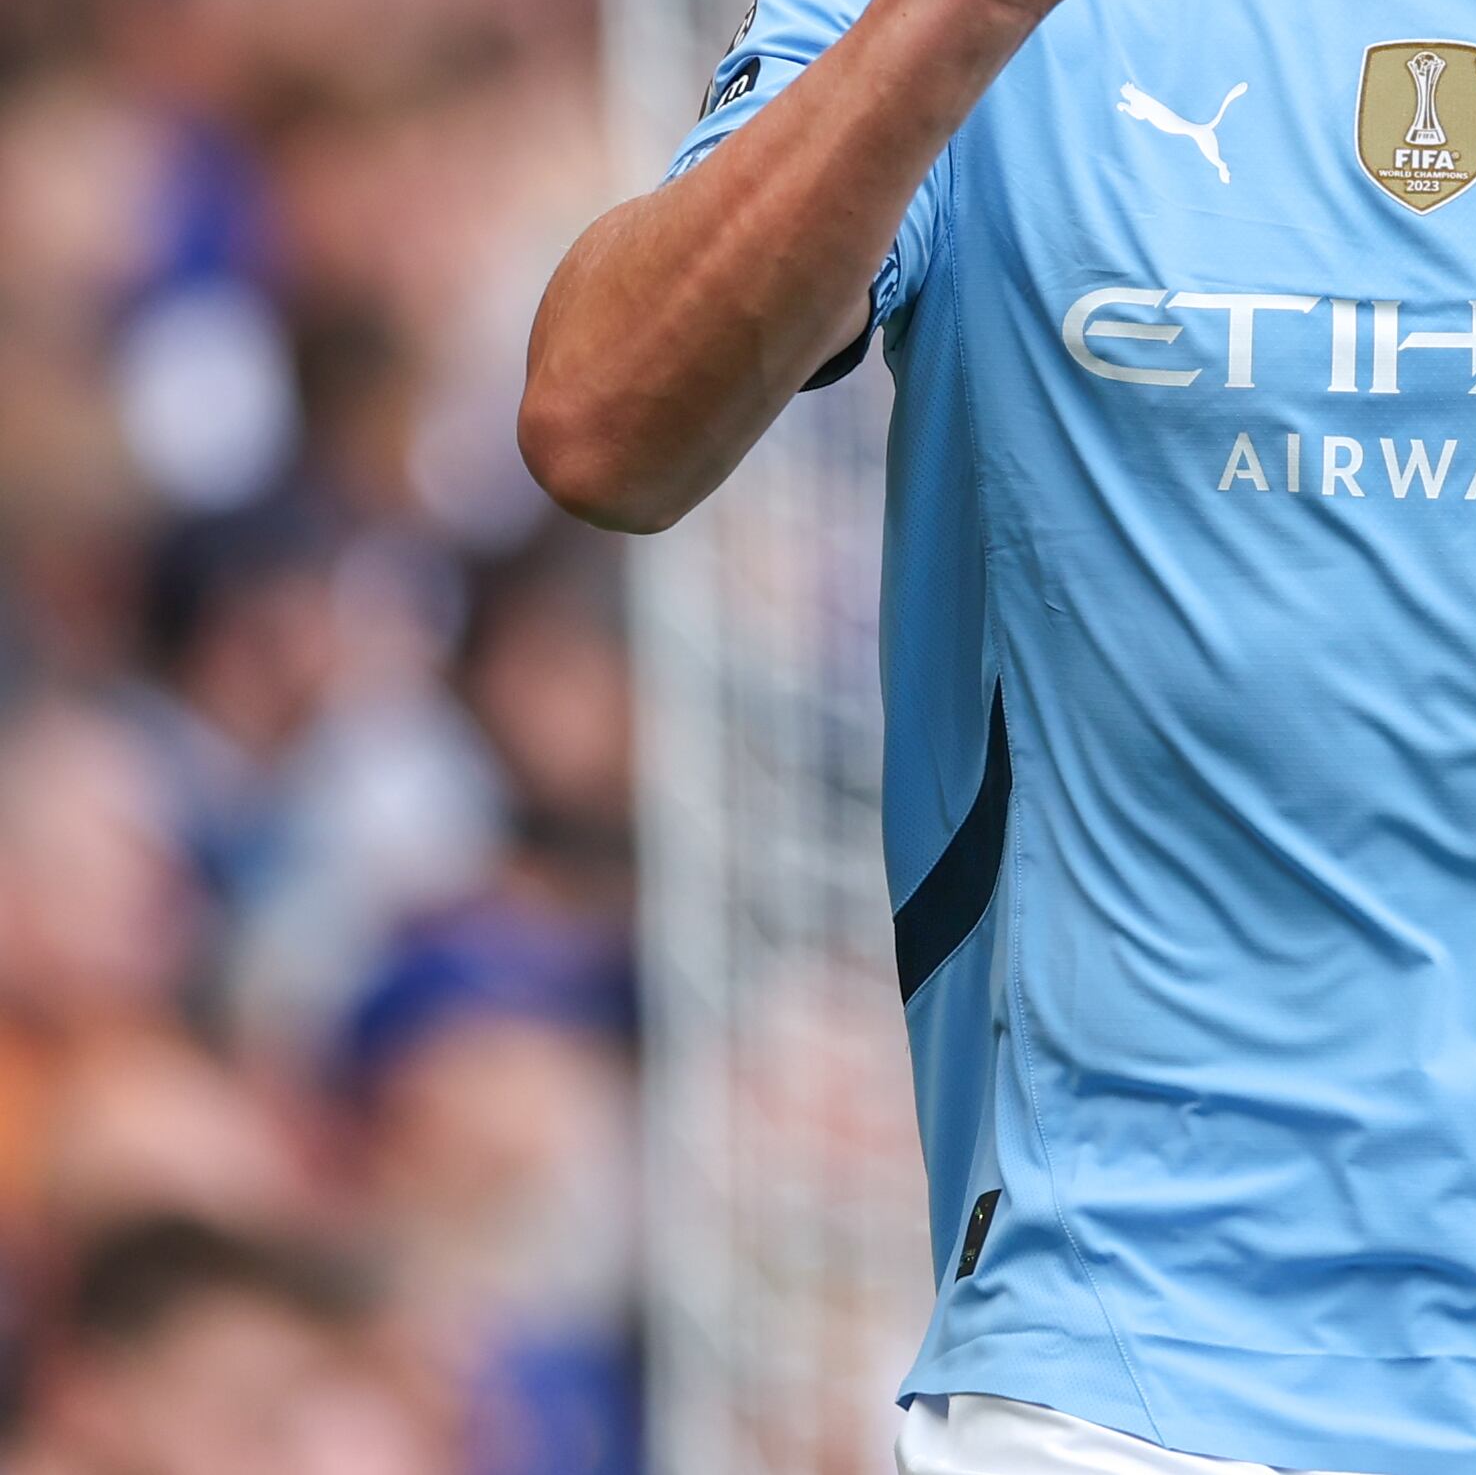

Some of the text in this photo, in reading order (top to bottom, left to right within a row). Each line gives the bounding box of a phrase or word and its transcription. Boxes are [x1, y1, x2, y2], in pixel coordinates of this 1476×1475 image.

[1417, 132, 1435, 140] FIFA
[1379, 170, 1469, 180] WORLD CHAMPIONS
[1406, 180, 1440, 192] 2023
